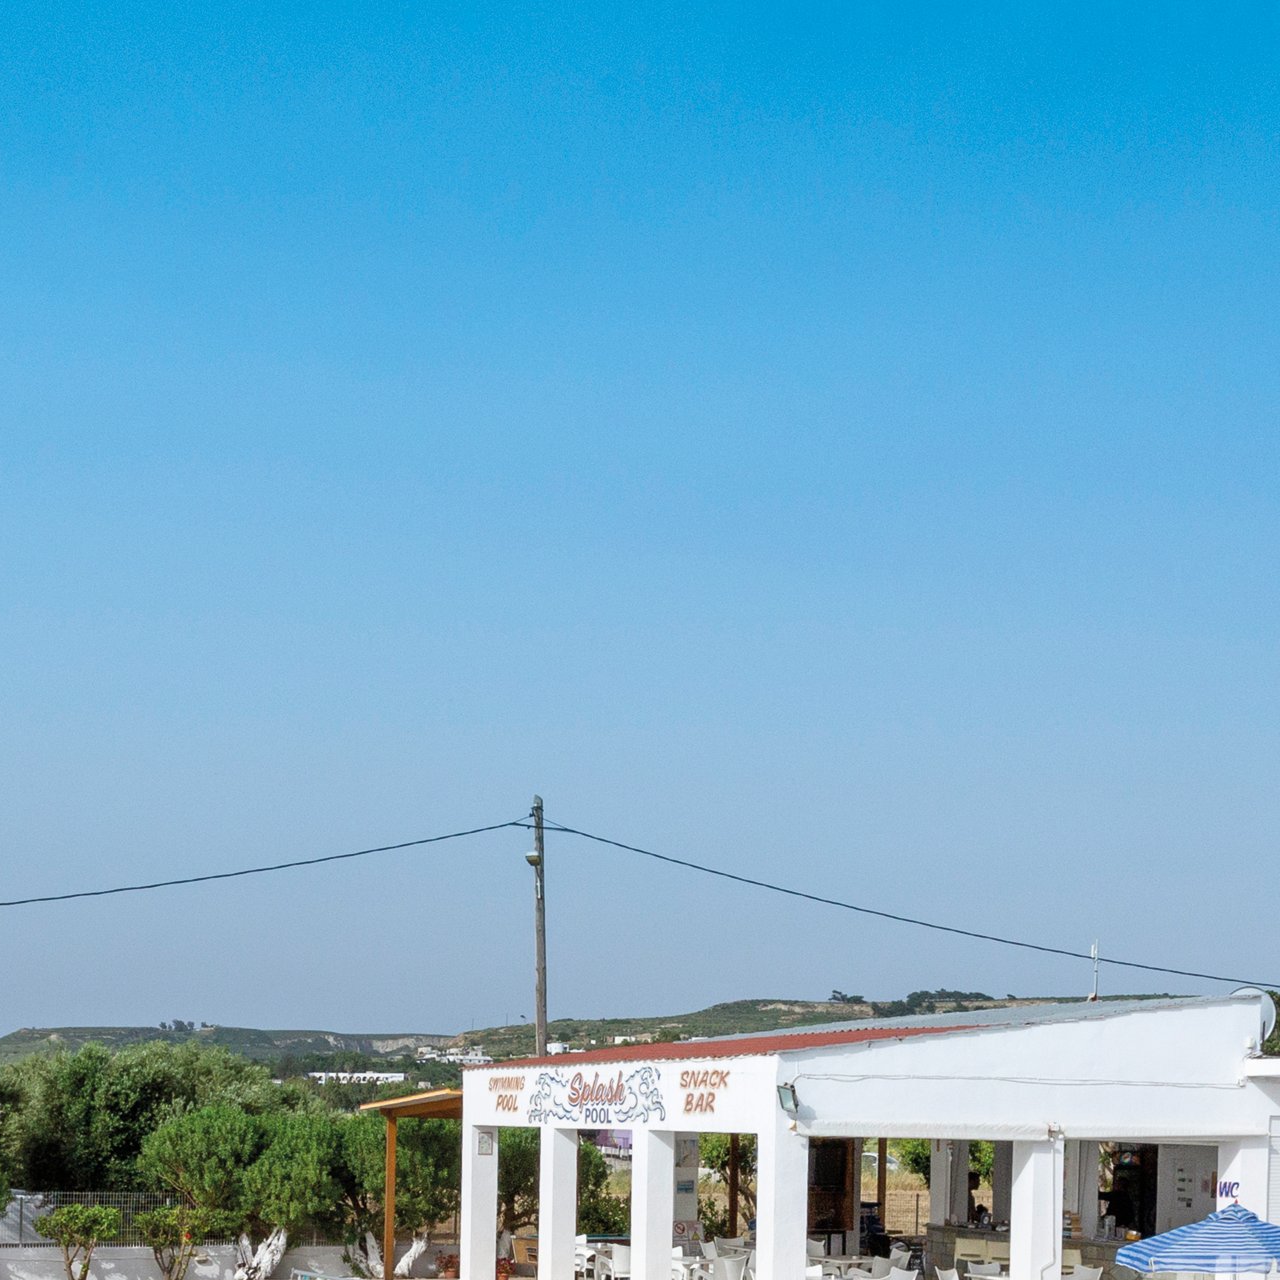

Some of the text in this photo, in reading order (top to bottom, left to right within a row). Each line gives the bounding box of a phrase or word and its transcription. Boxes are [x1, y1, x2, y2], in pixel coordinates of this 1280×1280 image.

[488, 1075, 526, 1092] SWIMMING
[679, 1069, 731, 1089] SNACK
[567, 1070, 627, 1113] Splash
[495, 1094, 519, 1112] POOL
[684, 1091, 716, 1113] BAR
[584, 1107, 612, 1124] POOL
[1218, 1180, 1240, 1198] WC
